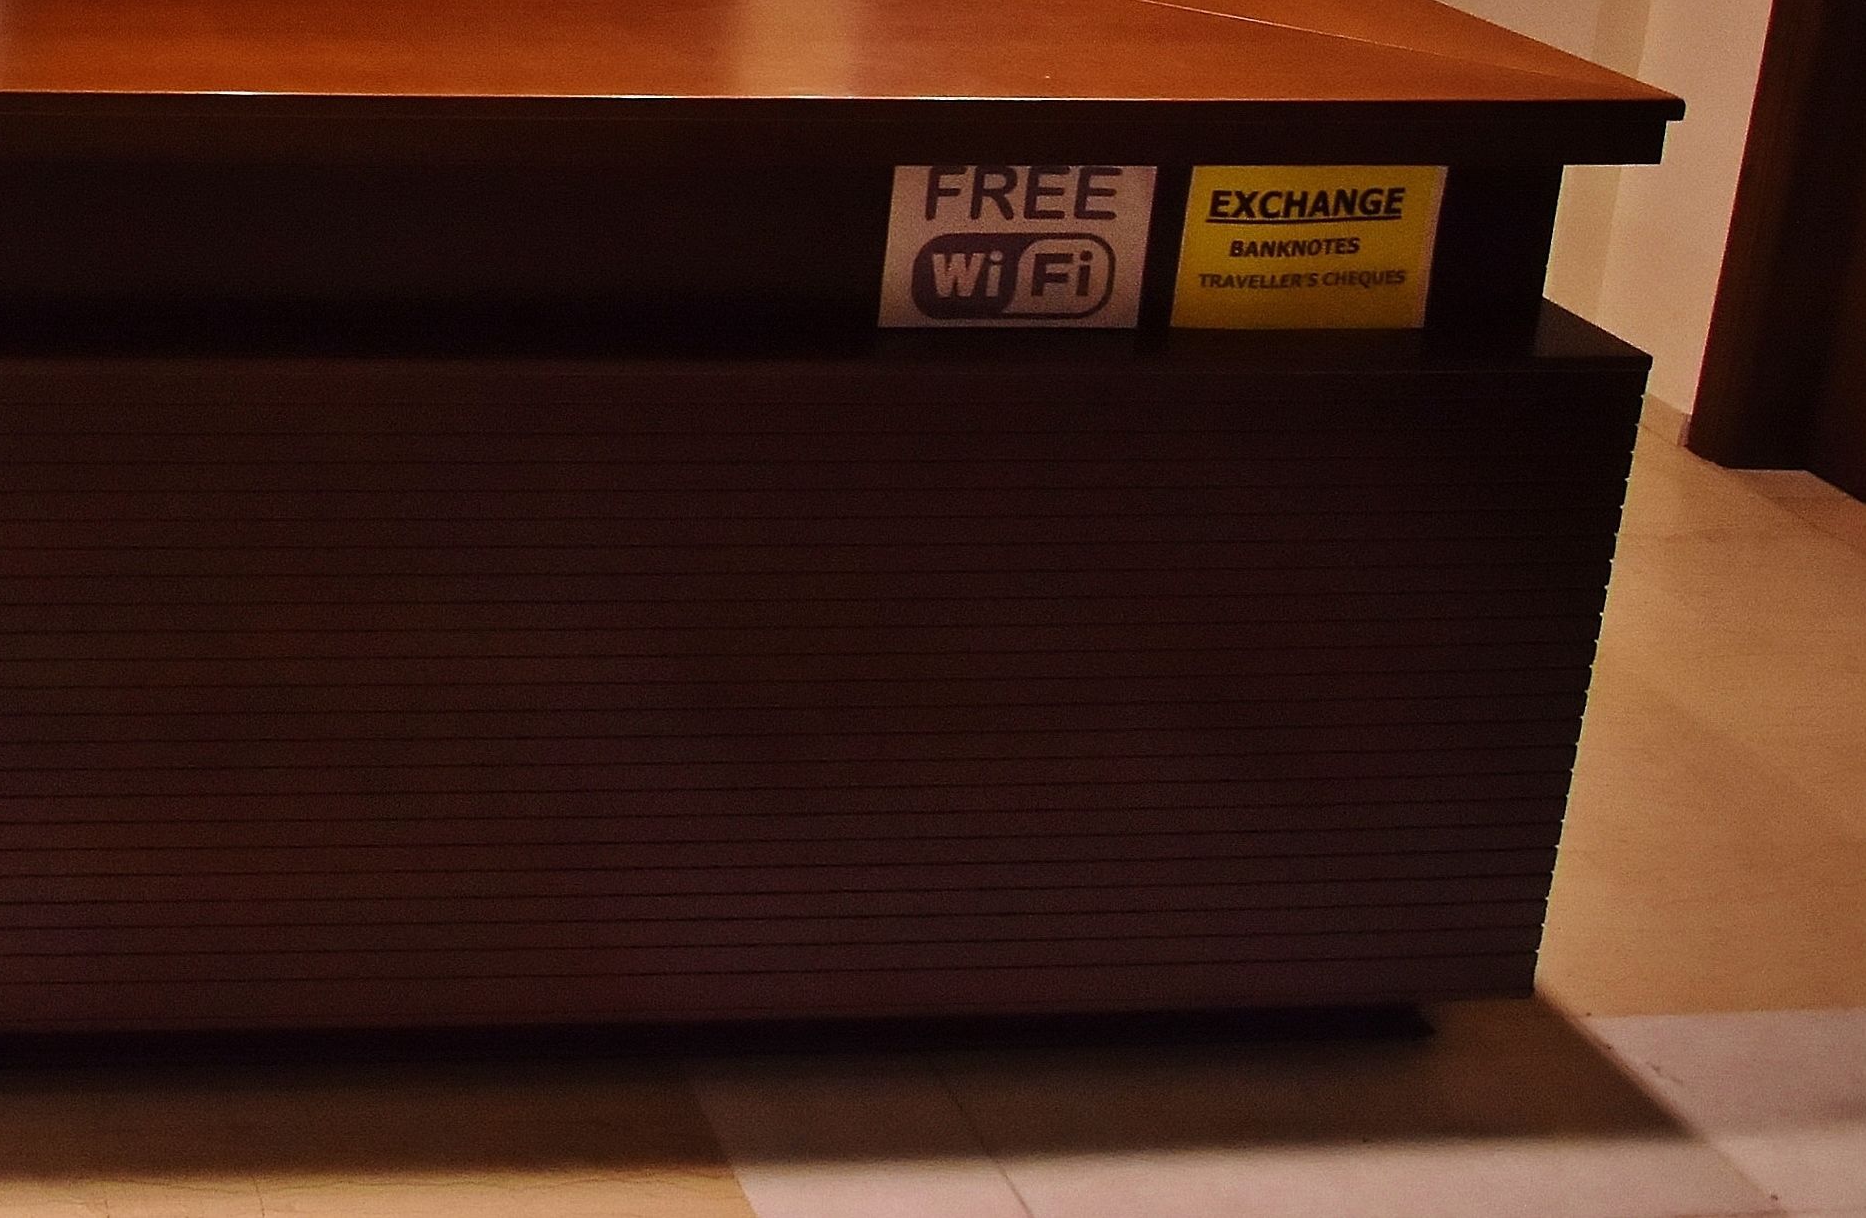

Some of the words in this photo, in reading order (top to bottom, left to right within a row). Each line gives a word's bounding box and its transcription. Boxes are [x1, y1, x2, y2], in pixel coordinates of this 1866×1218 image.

[925, 167, 1123, 221] FREE
[1208, 187, 1406, 219] EXCHANGE
[1228, 237, 1361, 258] BANKNOTES
[1198, 271, 1319, 290] TRAVELLER'S
[1322, 270, 1406, 289] CHEQUES
